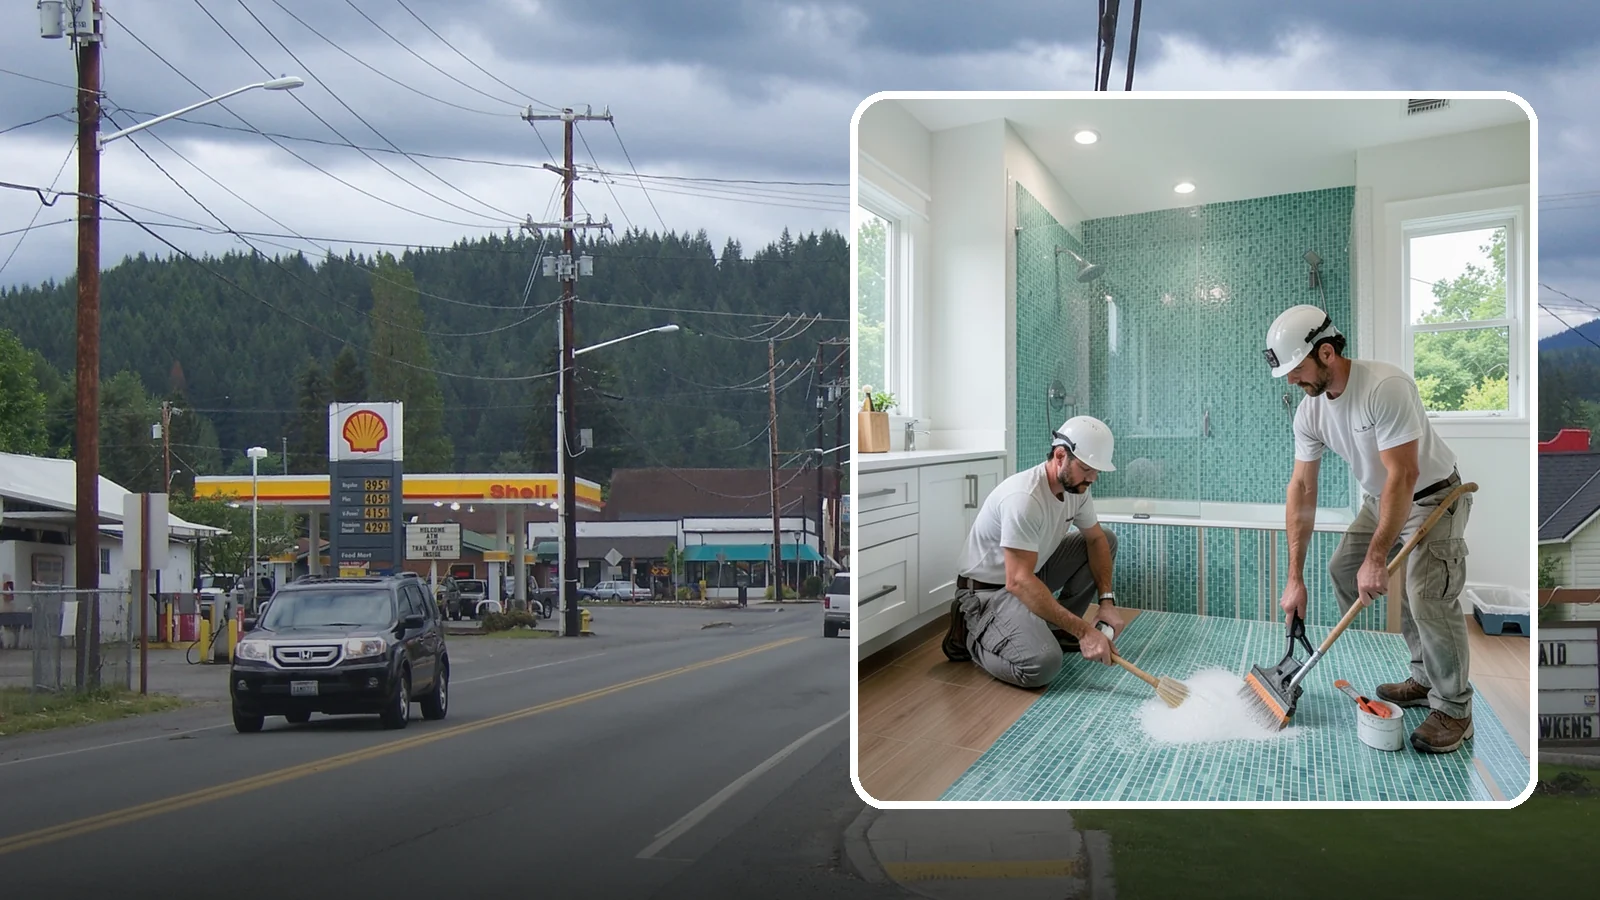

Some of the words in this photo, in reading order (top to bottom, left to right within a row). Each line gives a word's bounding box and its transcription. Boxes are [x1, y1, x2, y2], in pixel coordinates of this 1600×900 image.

[365, 480, 383, 490] 395
[490, 484, 547, 498] Shell
[365, 494, 383, 504] 405
[365, 508, 383, 518] 415
[366, 522, 383, 532] 429
